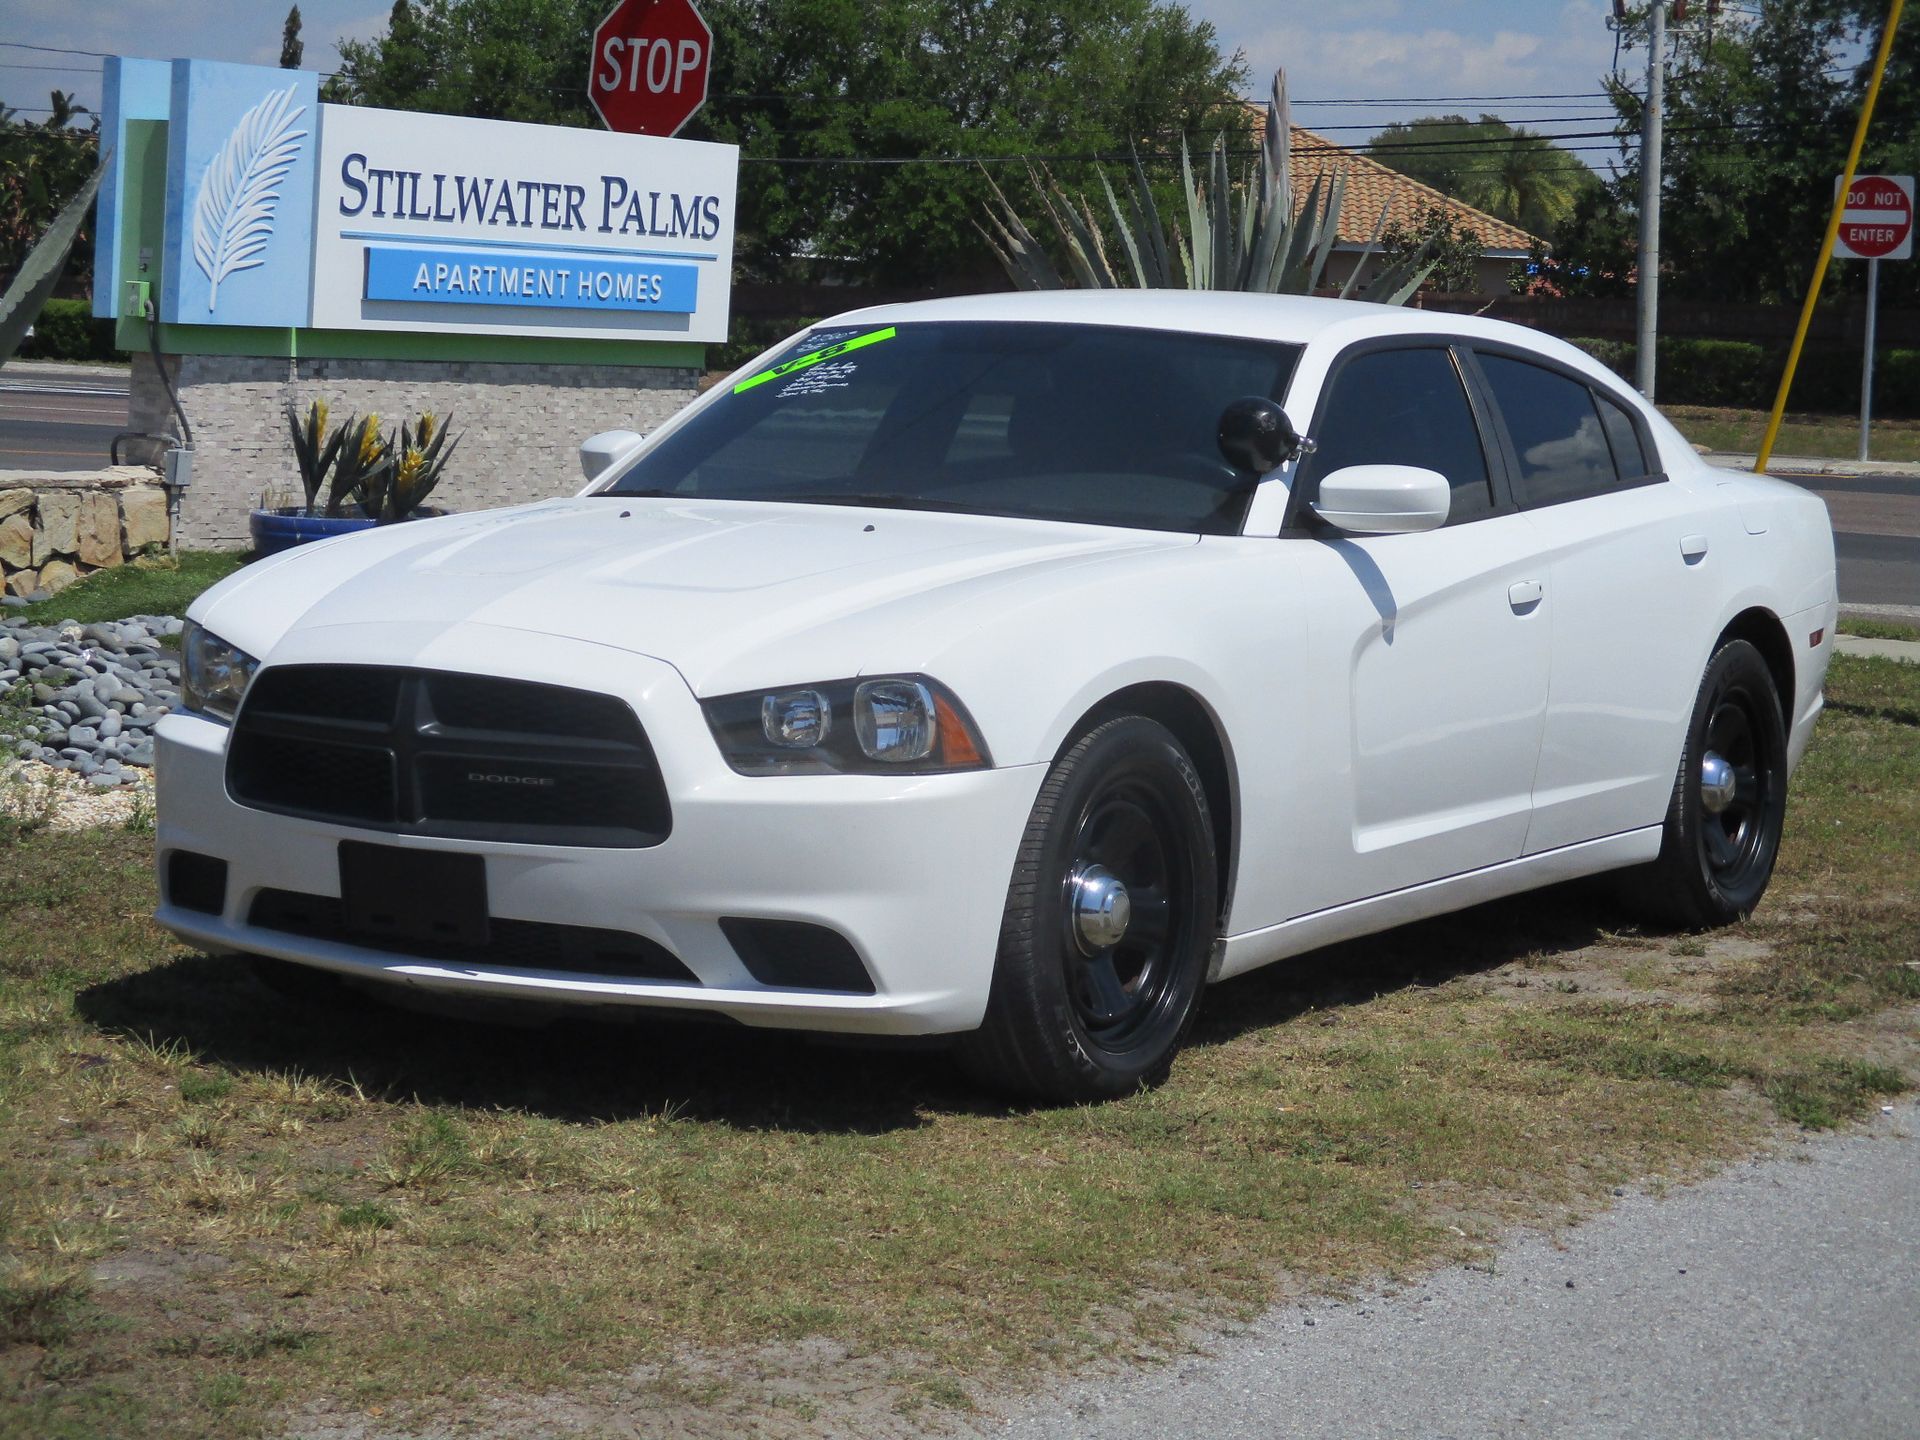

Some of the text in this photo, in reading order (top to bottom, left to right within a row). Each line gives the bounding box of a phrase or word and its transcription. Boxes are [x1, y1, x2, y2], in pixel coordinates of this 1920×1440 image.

[600, 36, 701, 94] STOP
[339, 153, 720, 240] STILLWATER PALMS
[1847, 192, 1902, 206] DO NOT
[1849, 228, 1895, 242] ENTER
[413, 262, 662, 301] APARTMENT HOMES
[468, 773, 555, 785] DODGE
